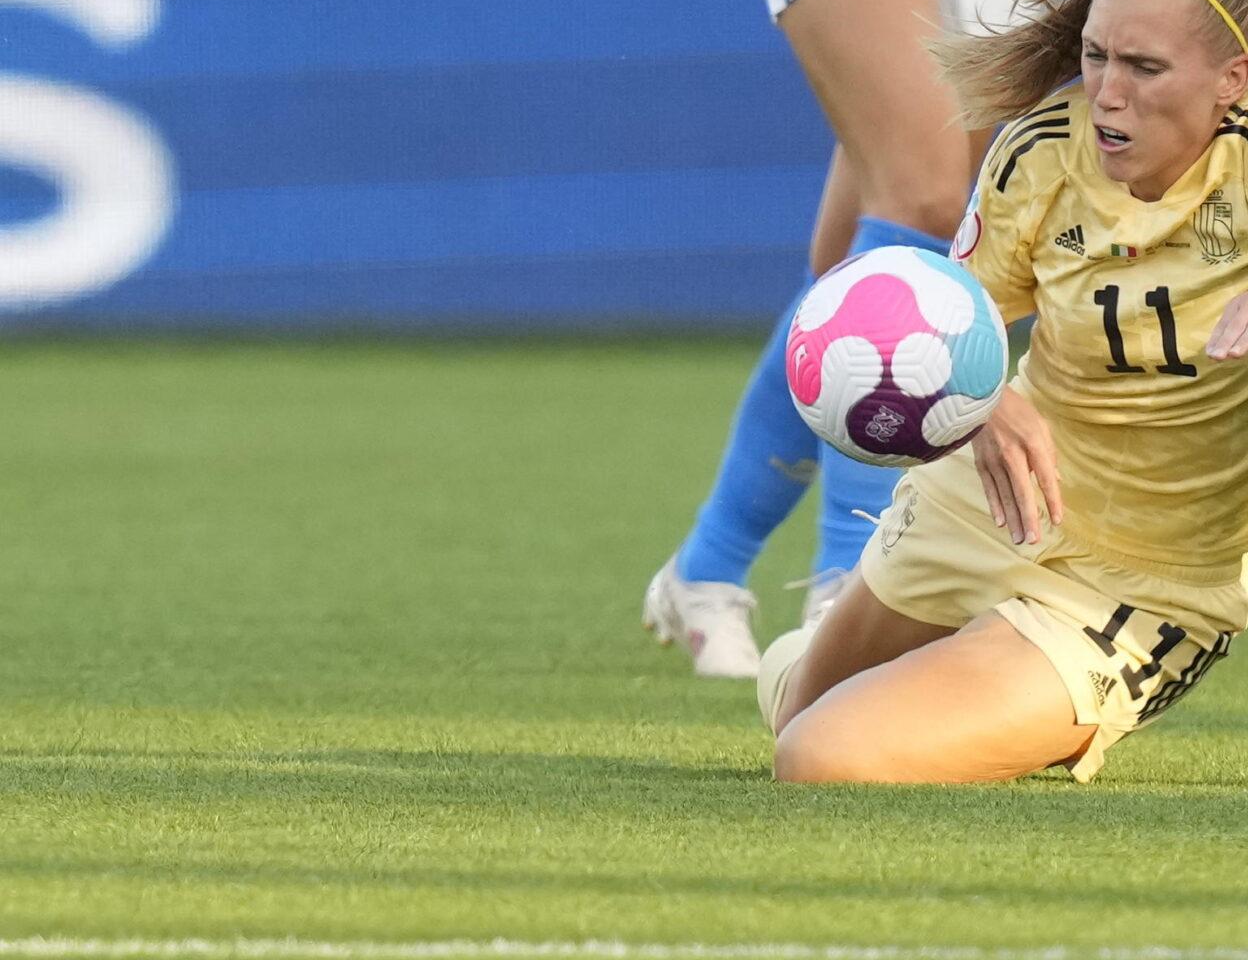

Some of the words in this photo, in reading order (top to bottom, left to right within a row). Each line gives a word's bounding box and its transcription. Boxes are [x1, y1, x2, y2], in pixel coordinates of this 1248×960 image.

[1054, 236, 1087, 257] adidas
[1094, 285, 1197, 377] 11
[1083, 603, 1187, 701] 11
